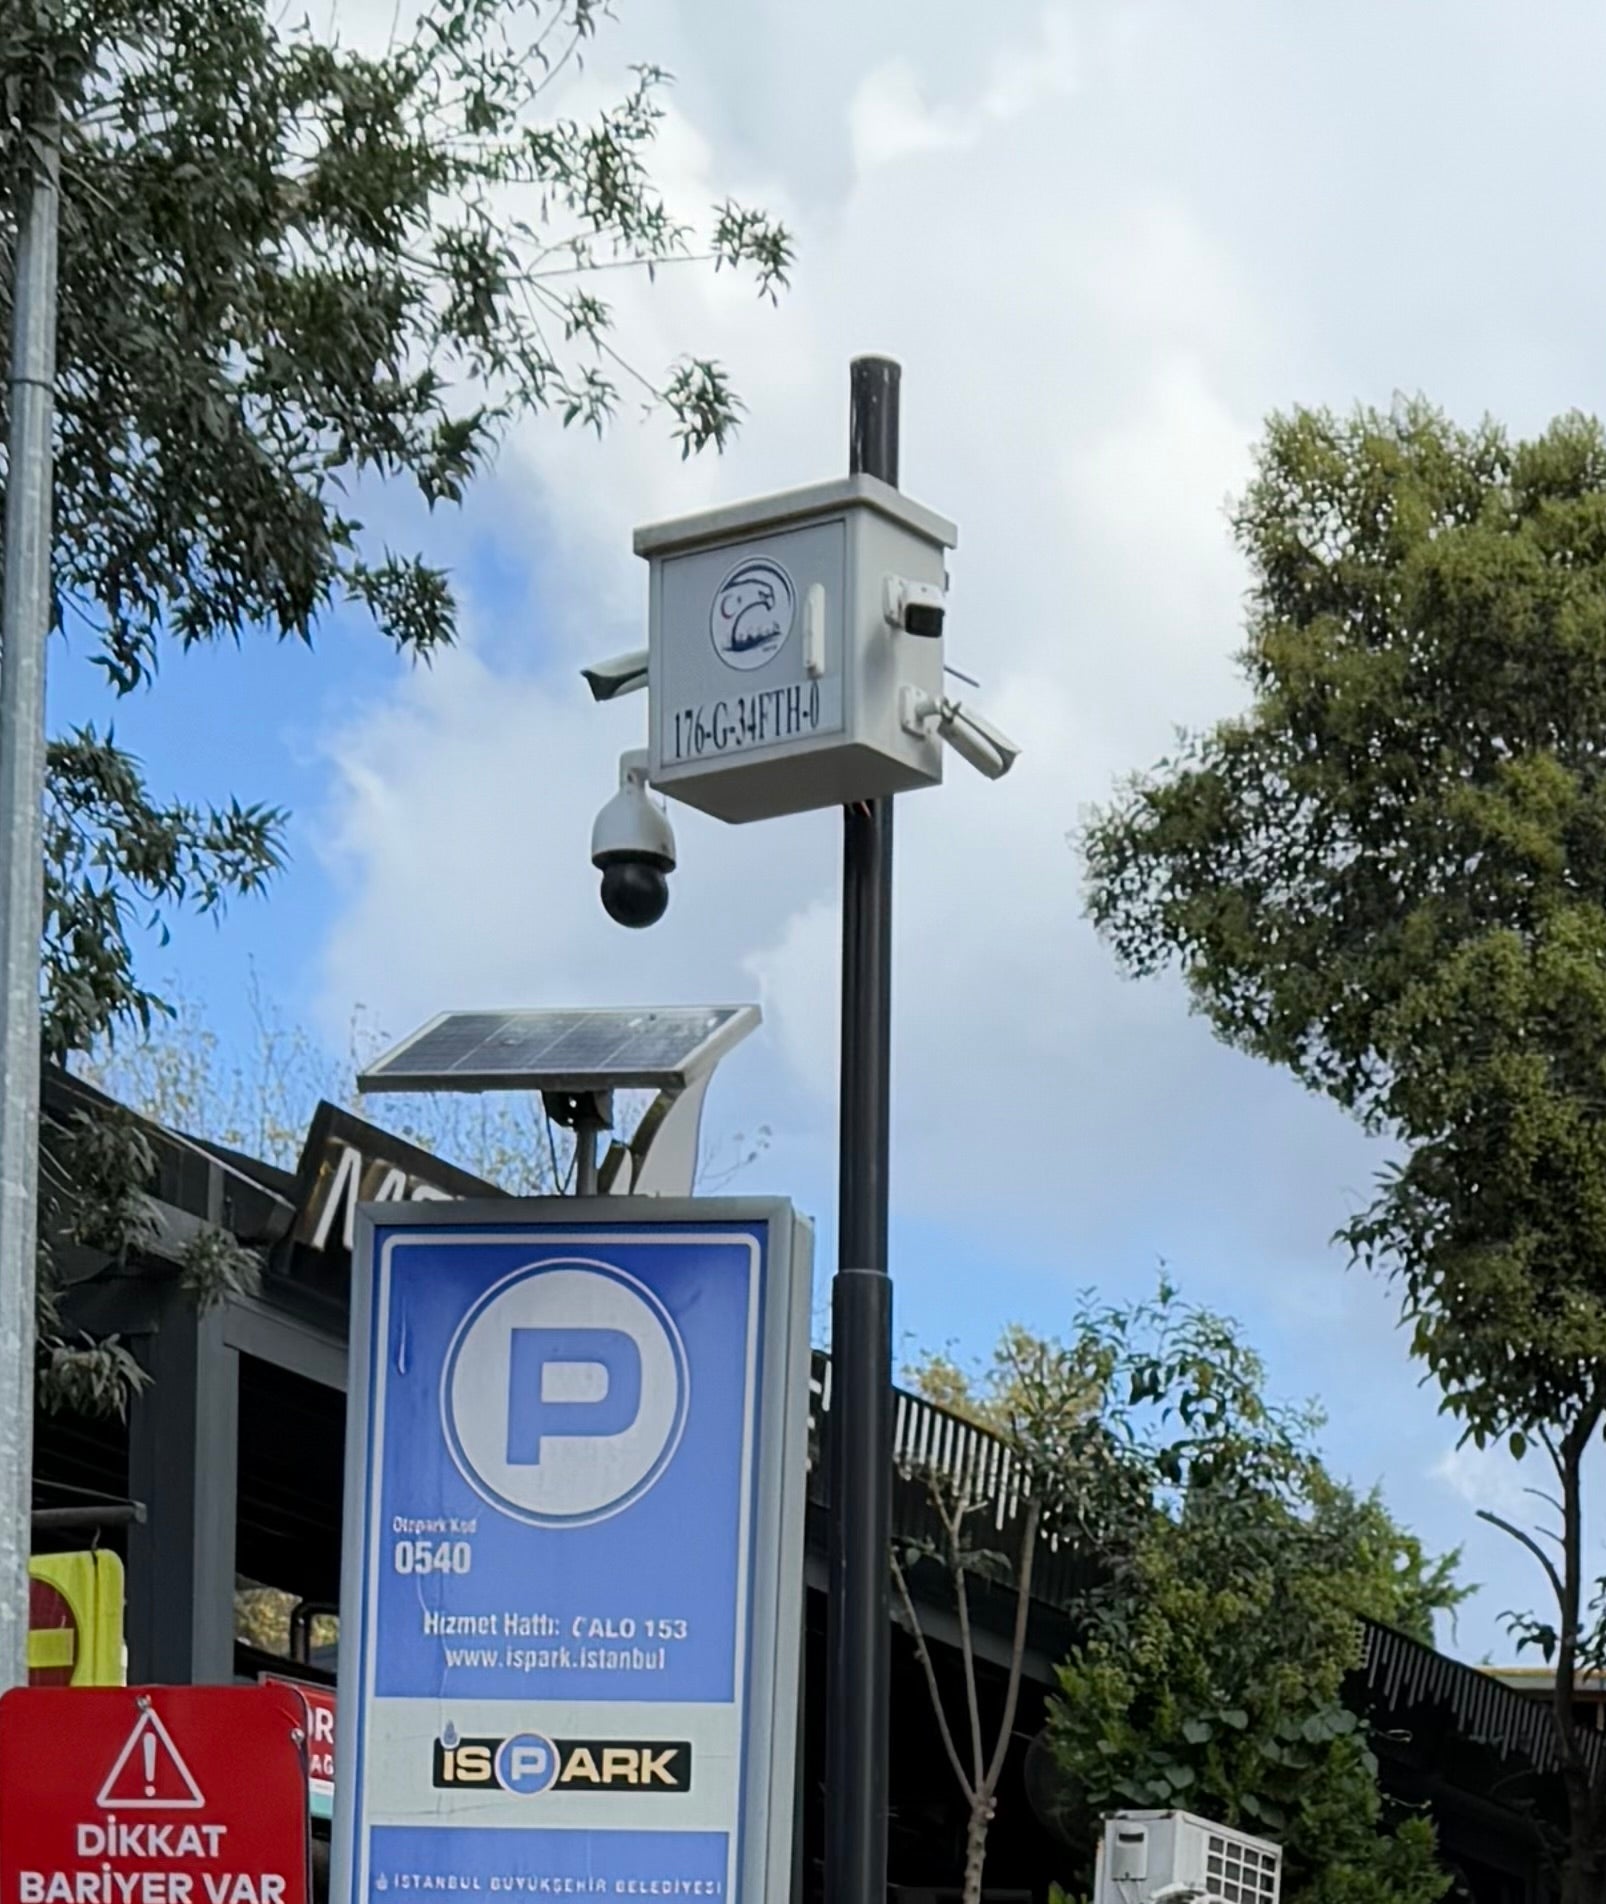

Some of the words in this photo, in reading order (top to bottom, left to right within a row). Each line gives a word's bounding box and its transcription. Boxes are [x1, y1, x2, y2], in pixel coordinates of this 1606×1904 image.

[675, 680, 820, 759] 176-G-34FTH-0
[506, 1328, 641, 1465] P
[395, 1540, 471, 1574] 0540
[423, 1611, 497, 1636] Hizmet
[645, 1619, 687, 1639] 153
[447, 1646, 665, 1672] www.ispark.istanbul
[77, 1814, 227, 1858] DİKKAT
